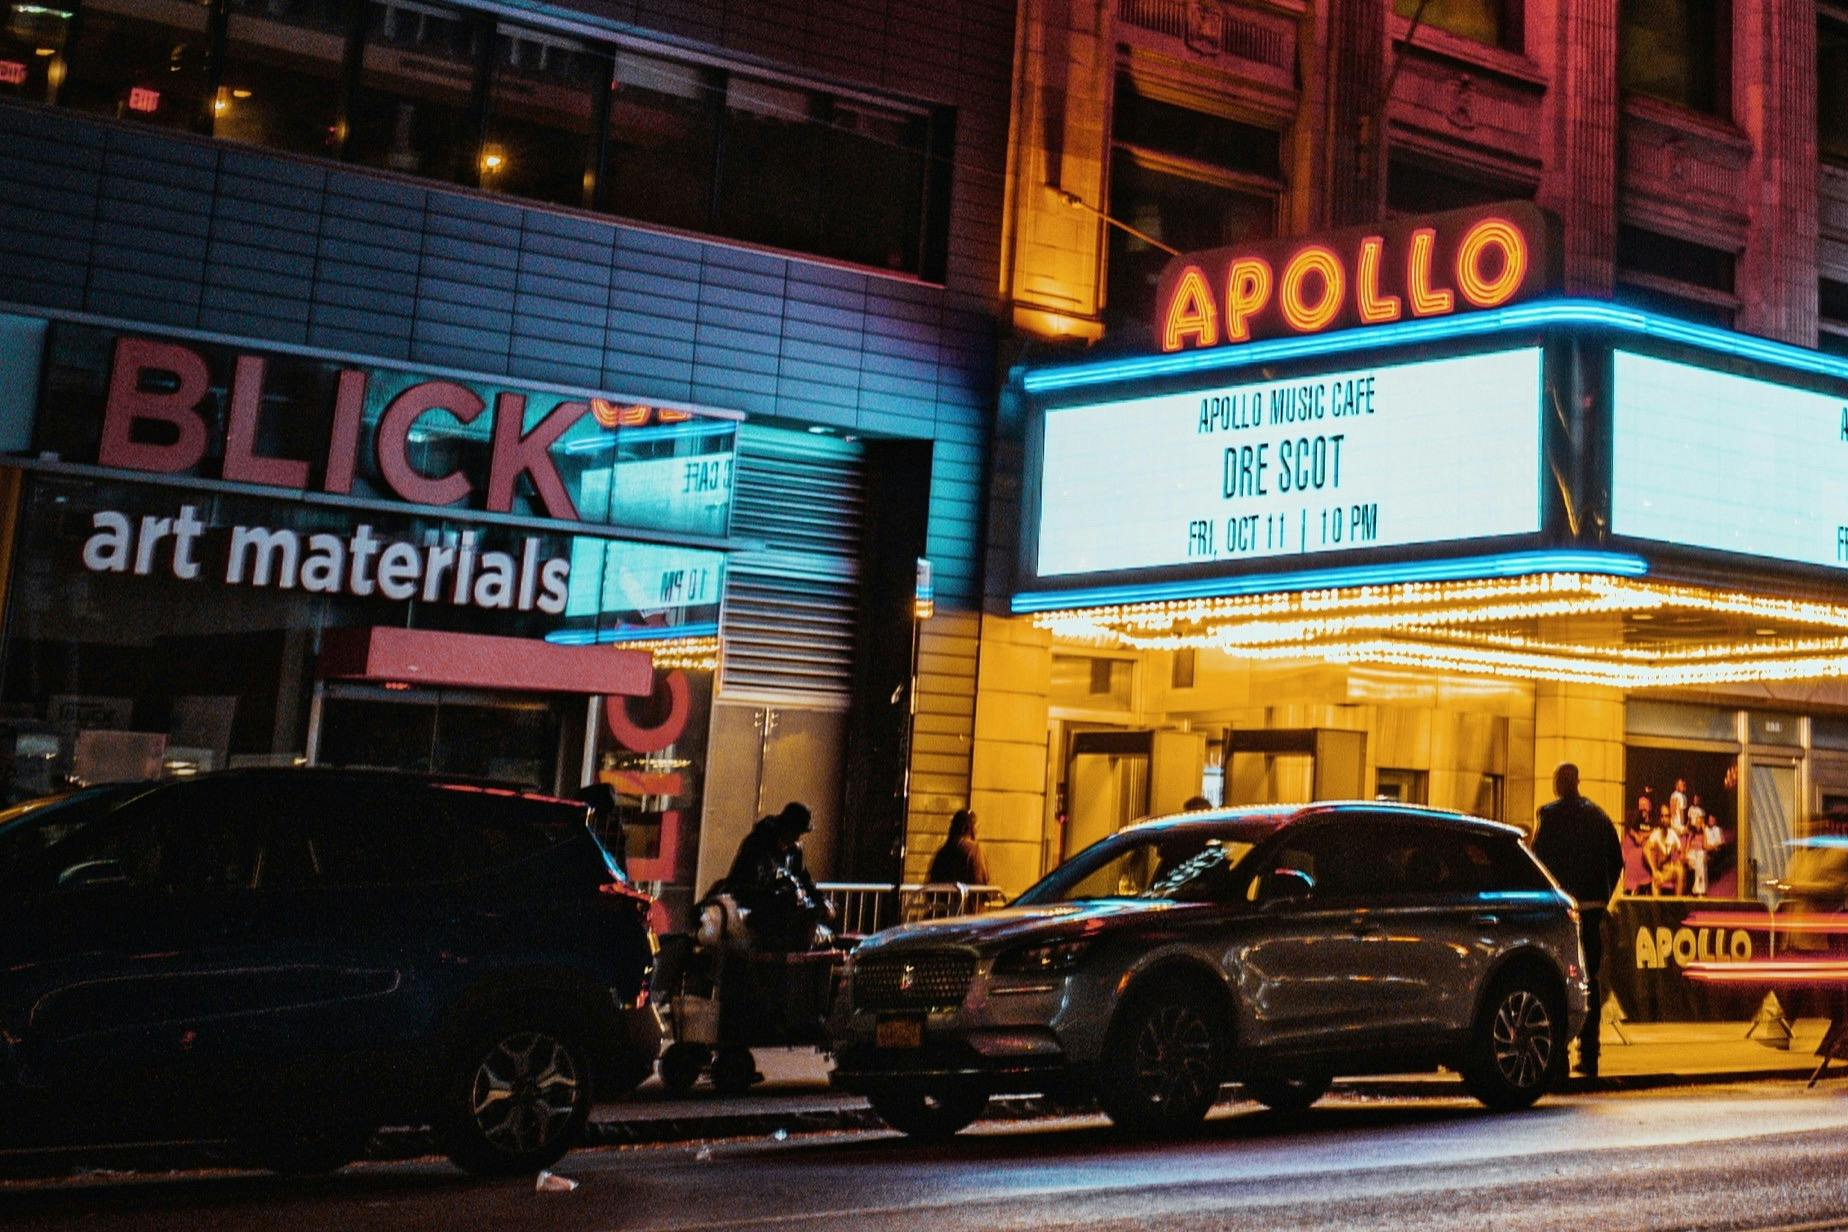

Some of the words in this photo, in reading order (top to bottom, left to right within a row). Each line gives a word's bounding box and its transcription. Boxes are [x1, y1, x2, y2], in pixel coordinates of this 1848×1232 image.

[1162, 216, 1528, 352] APOLLO
[98, 336, 588, 520] BLICK
[1198, 391, 1262, 434] APOLLO
[1269, 382, 1325, 426] MUSIC
[1222, 441, 1269, 500] DRE
[1277, 434, 1345, 494] SCOT
[83, 505, 202, 579] art
[226, 524, 570, 615] materials
[1188, 519, 1218, 561] FRI,
[1227, 515, 1259, 552] OCT
[1266, 512, 1286, 549] 11
[1320, 508, 1343, 544] 10
[1350, 503, 1379, 542] PM
[1635, 926, 1752, 968] APOLLO
